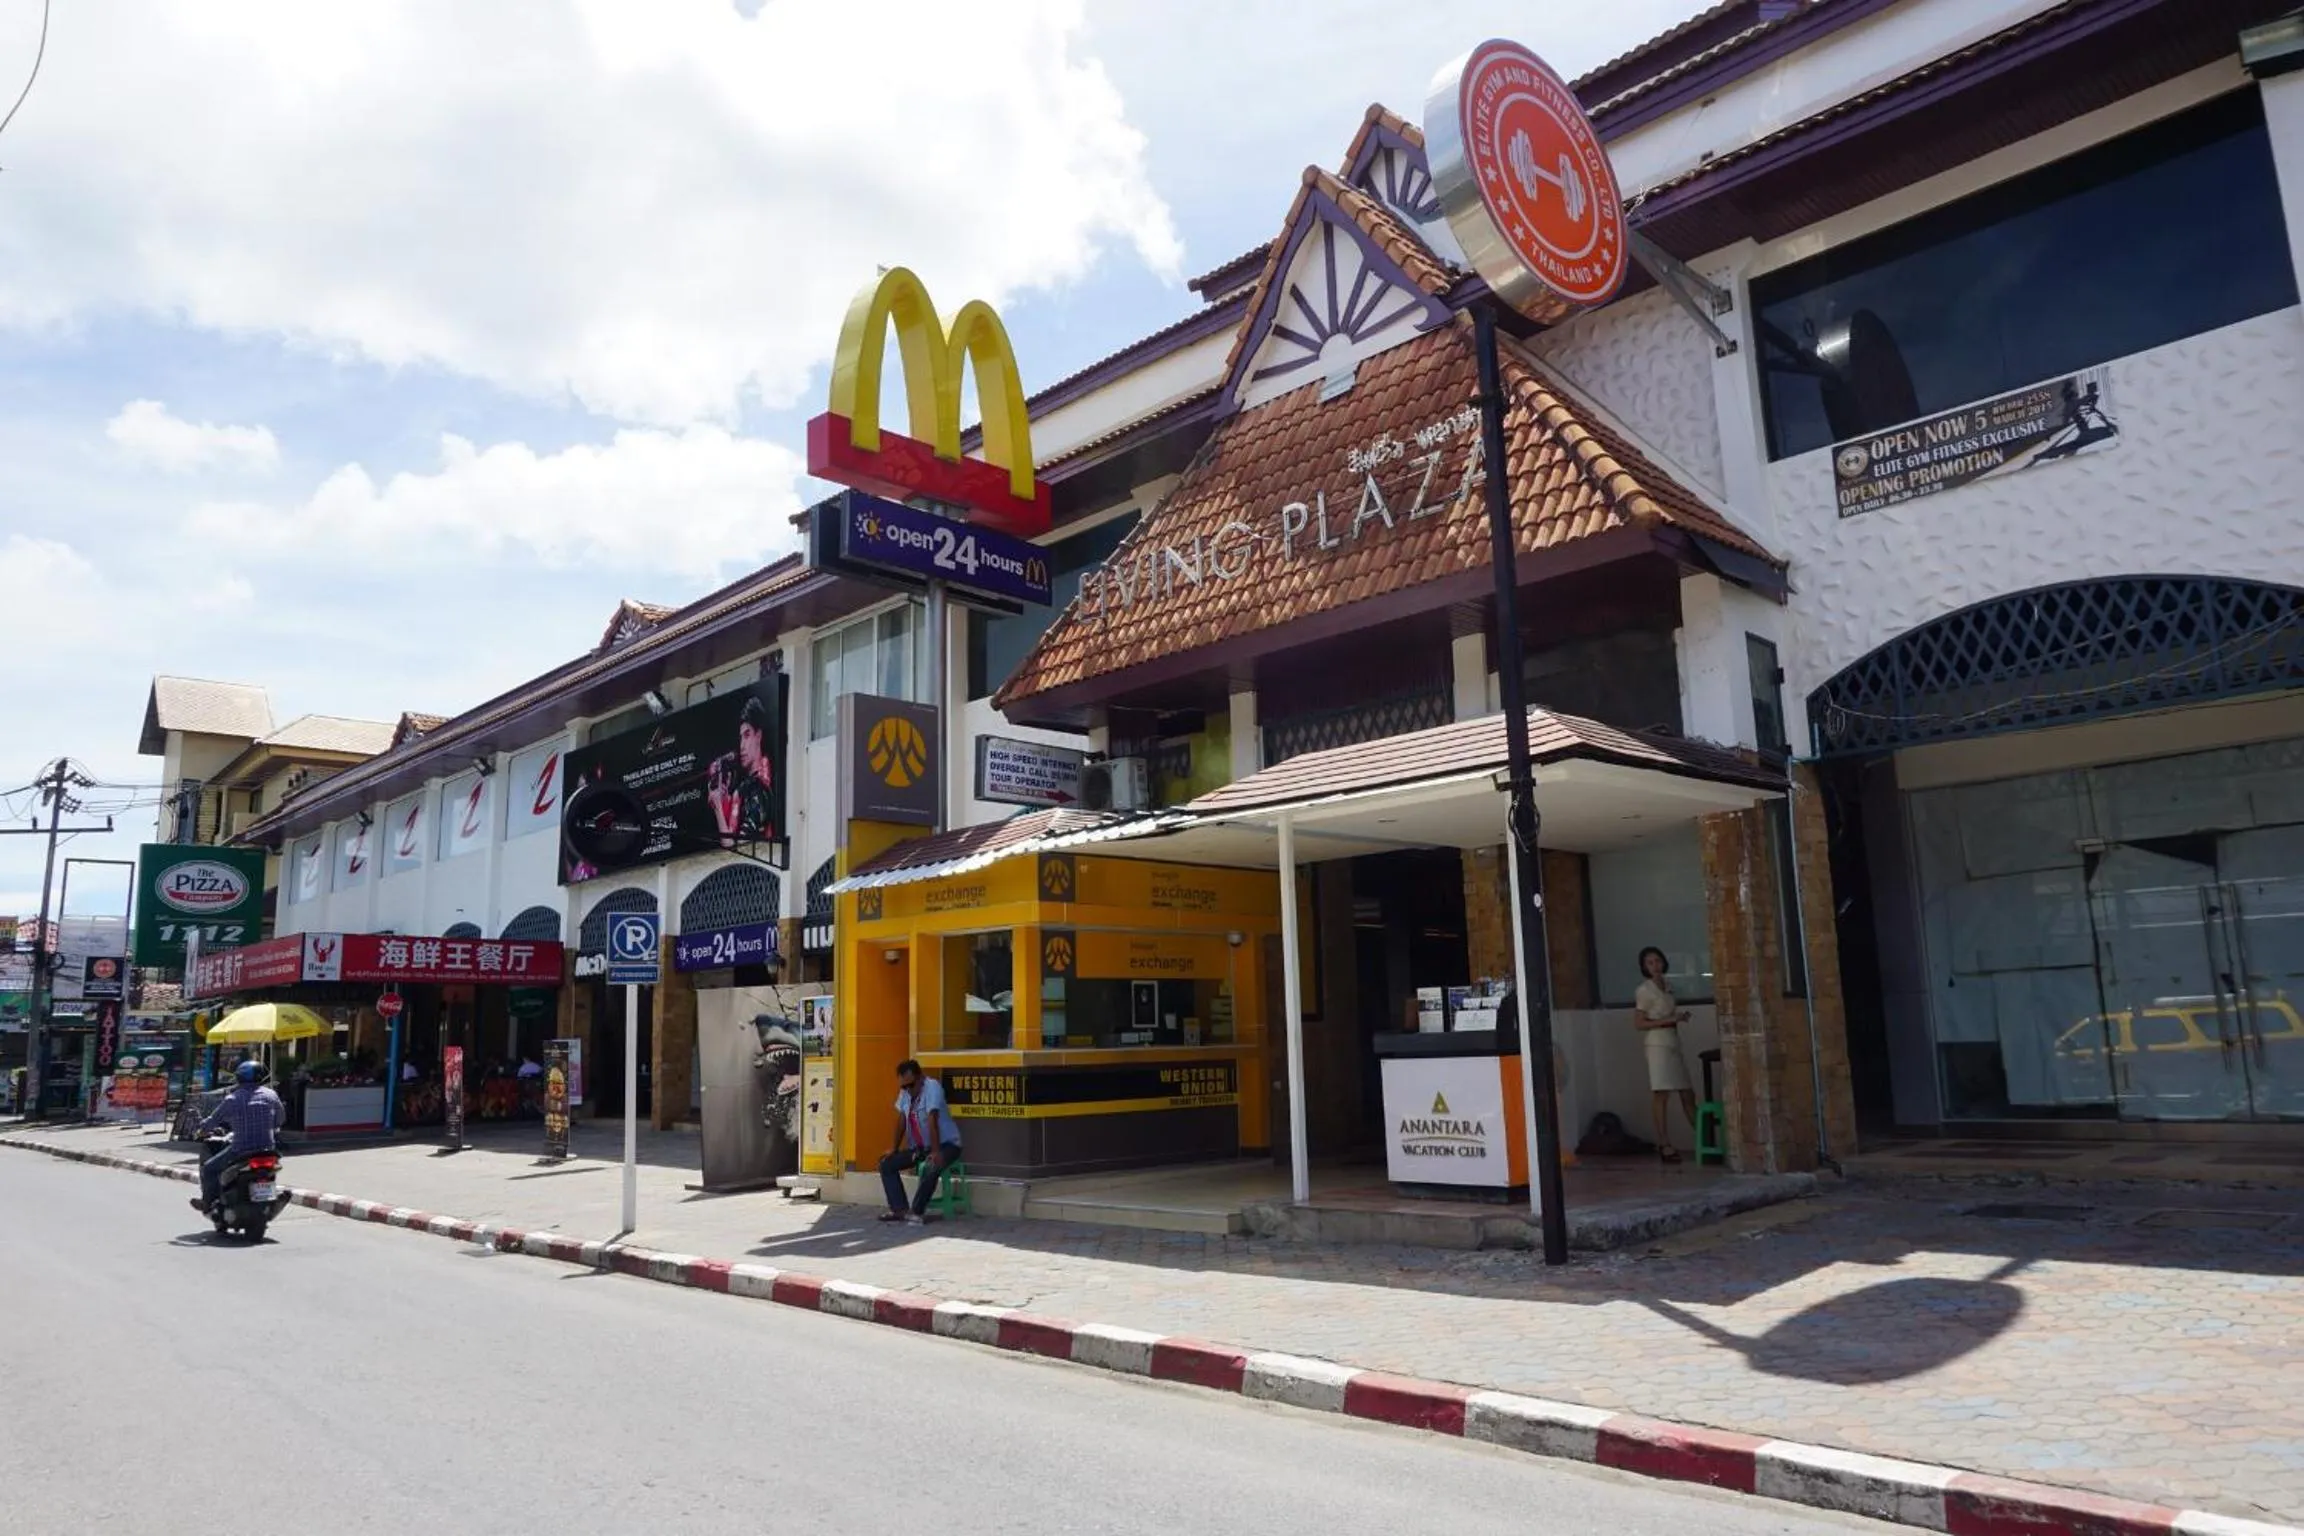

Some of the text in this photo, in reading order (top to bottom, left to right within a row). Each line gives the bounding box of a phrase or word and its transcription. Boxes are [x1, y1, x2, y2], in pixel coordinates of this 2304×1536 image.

[1482, 73, 1505, 99] GYM
[1504, 66, 1530, 87] AND
[1532, 76, 1587, 143] FITNESS
[1476, 100, 1491, 157] ELITE
[1530, 241, 1592, 285] THAILAND
[1871, 410, 1988, 460] OPEN NOW 5
[1873, 417, 2049, 477] ELITE GYM FITNESS EXCLUSIVE
[1839, 449, 2005, 506] OPENING PROMOTION
[1078, 437, 1488, 626] LIVING PLAZA
[886, 523, 1025, 577] open 24 hours
[990, 750, 1078, 770] HIGH SPEED INTERNET
[990, 761, 1026, 774] OVERSEA
[1028, 766, 1048, 778] CALL
[990, 772, 1057, 789] TOUR OPERATOR
[175, 874, 234, 892] PIZZA
[926, 885, 987, 904] exchange
[1151, 885, 1218, 904] exchange
[159, 924, 245, 941] 1112
[377, 939, 536, 973] 海鲜王餐厅
[692, 932, 763, 965] open 24 hours
[952, 1075, 1016, 1090] WESTERN
[1160, 1067, 1226, 1083] WESTERN
[970, 1089, 1016, 1104] UNION
[1181, 1080, 1225, 1095] UNION
[1399, 1119, 1486, 1136] ANANTARA
[1401, 1144, 1488, 1159] VACATION CLUB
